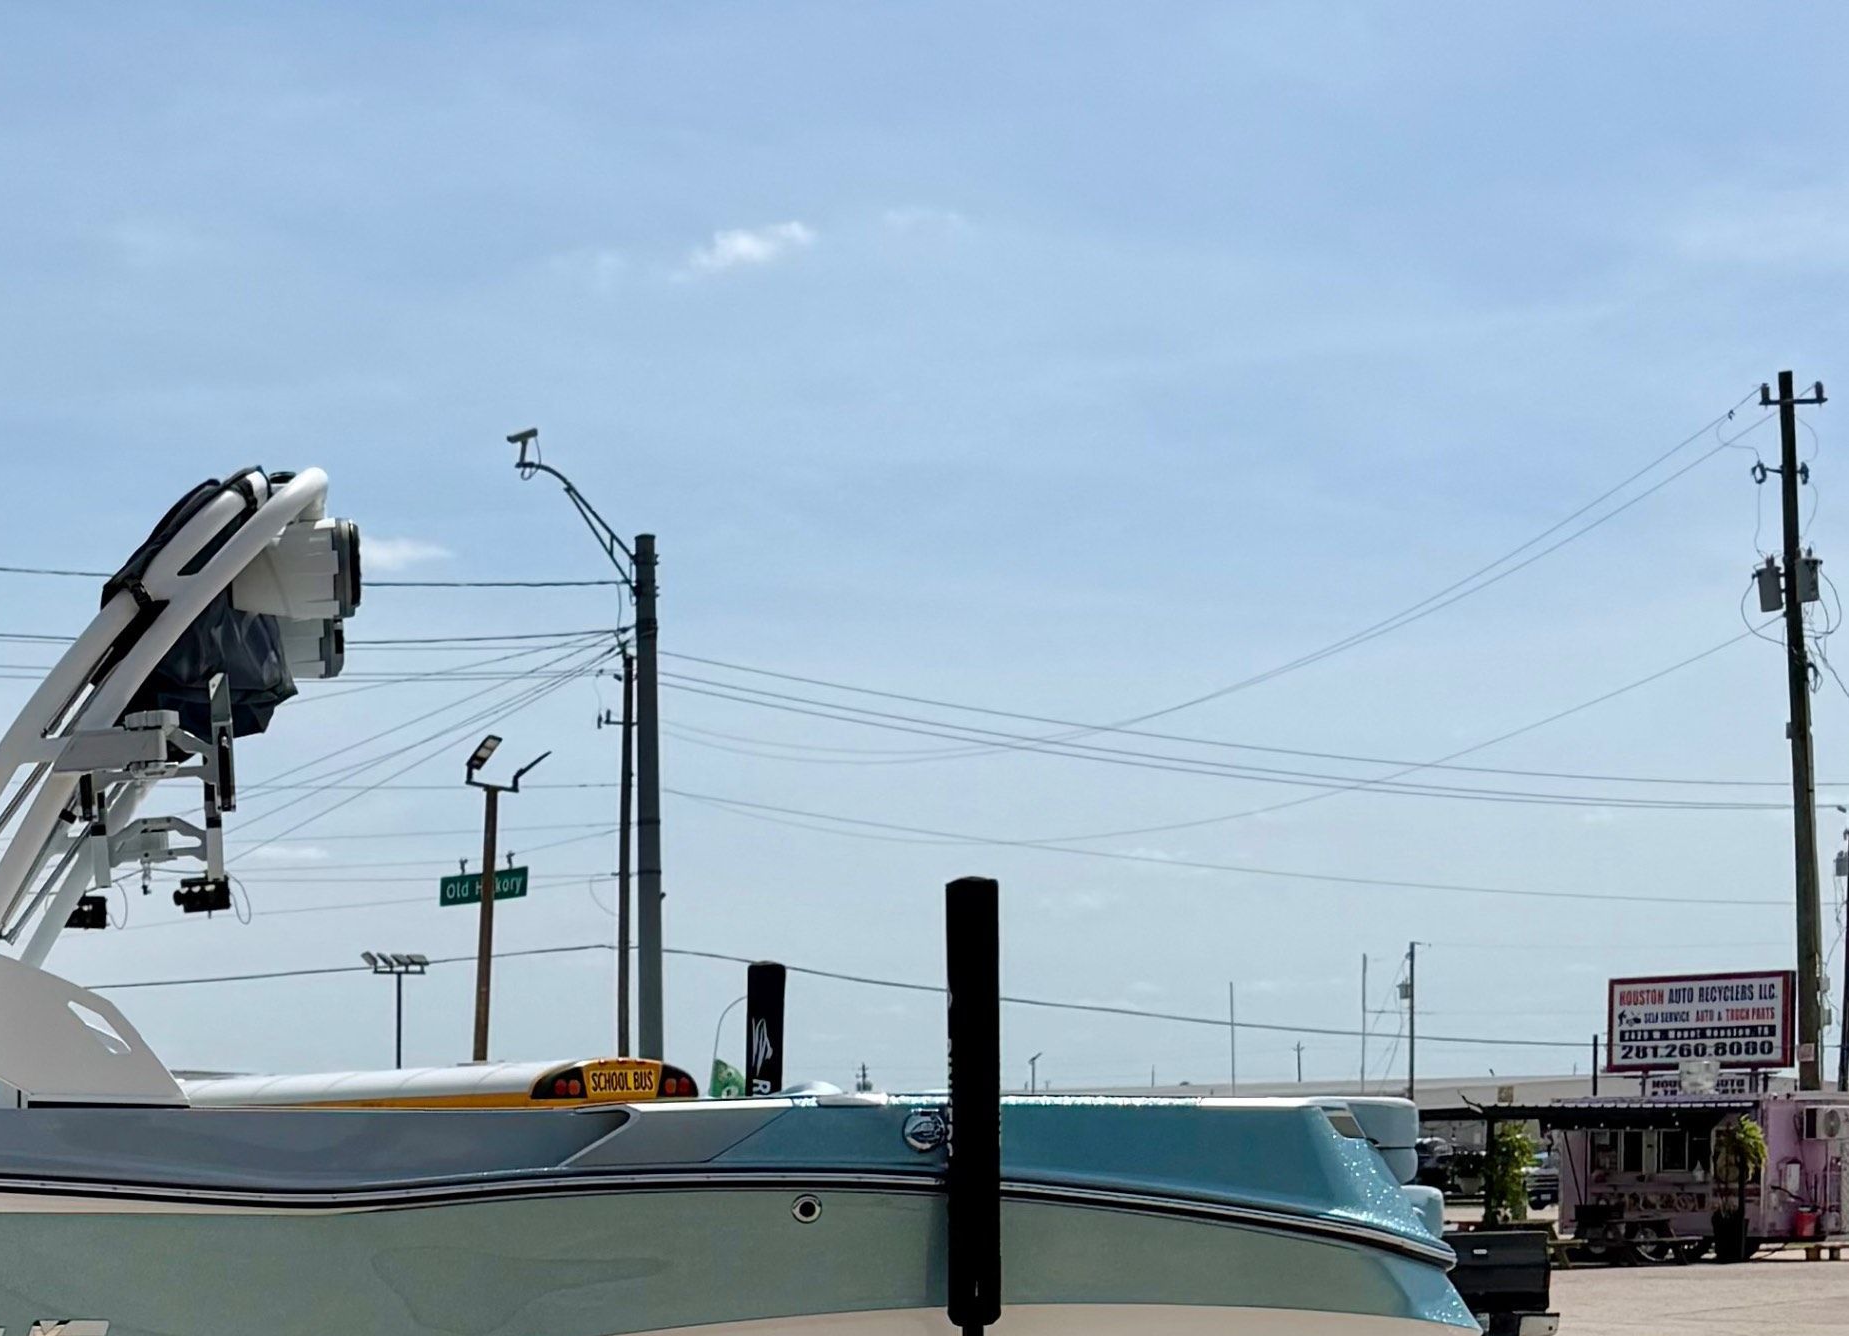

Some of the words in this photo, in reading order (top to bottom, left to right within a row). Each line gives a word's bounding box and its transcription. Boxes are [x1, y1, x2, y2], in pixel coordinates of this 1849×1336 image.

[446, 881, 469, 899] Old
[475, 876, 523, 895] Hkory
[1619, 989, 1664, 1006] HOUSTON
[1667, 987, 1694, 1004] AUTO
[1699, 985, 1754, 1003] RECYCLERS
[1660, 1011, 1690, 1023] SERVICE
[1695, 1010, 1714, 1022] AUTO
[1751, 1007, 1775, 1020] PARTS
[1621, 1040, 1774, 1060] 281.260.8080
[591, 1071, 632, 1092] SCHOOL
[633, 1070, 654, 1091] BUS
